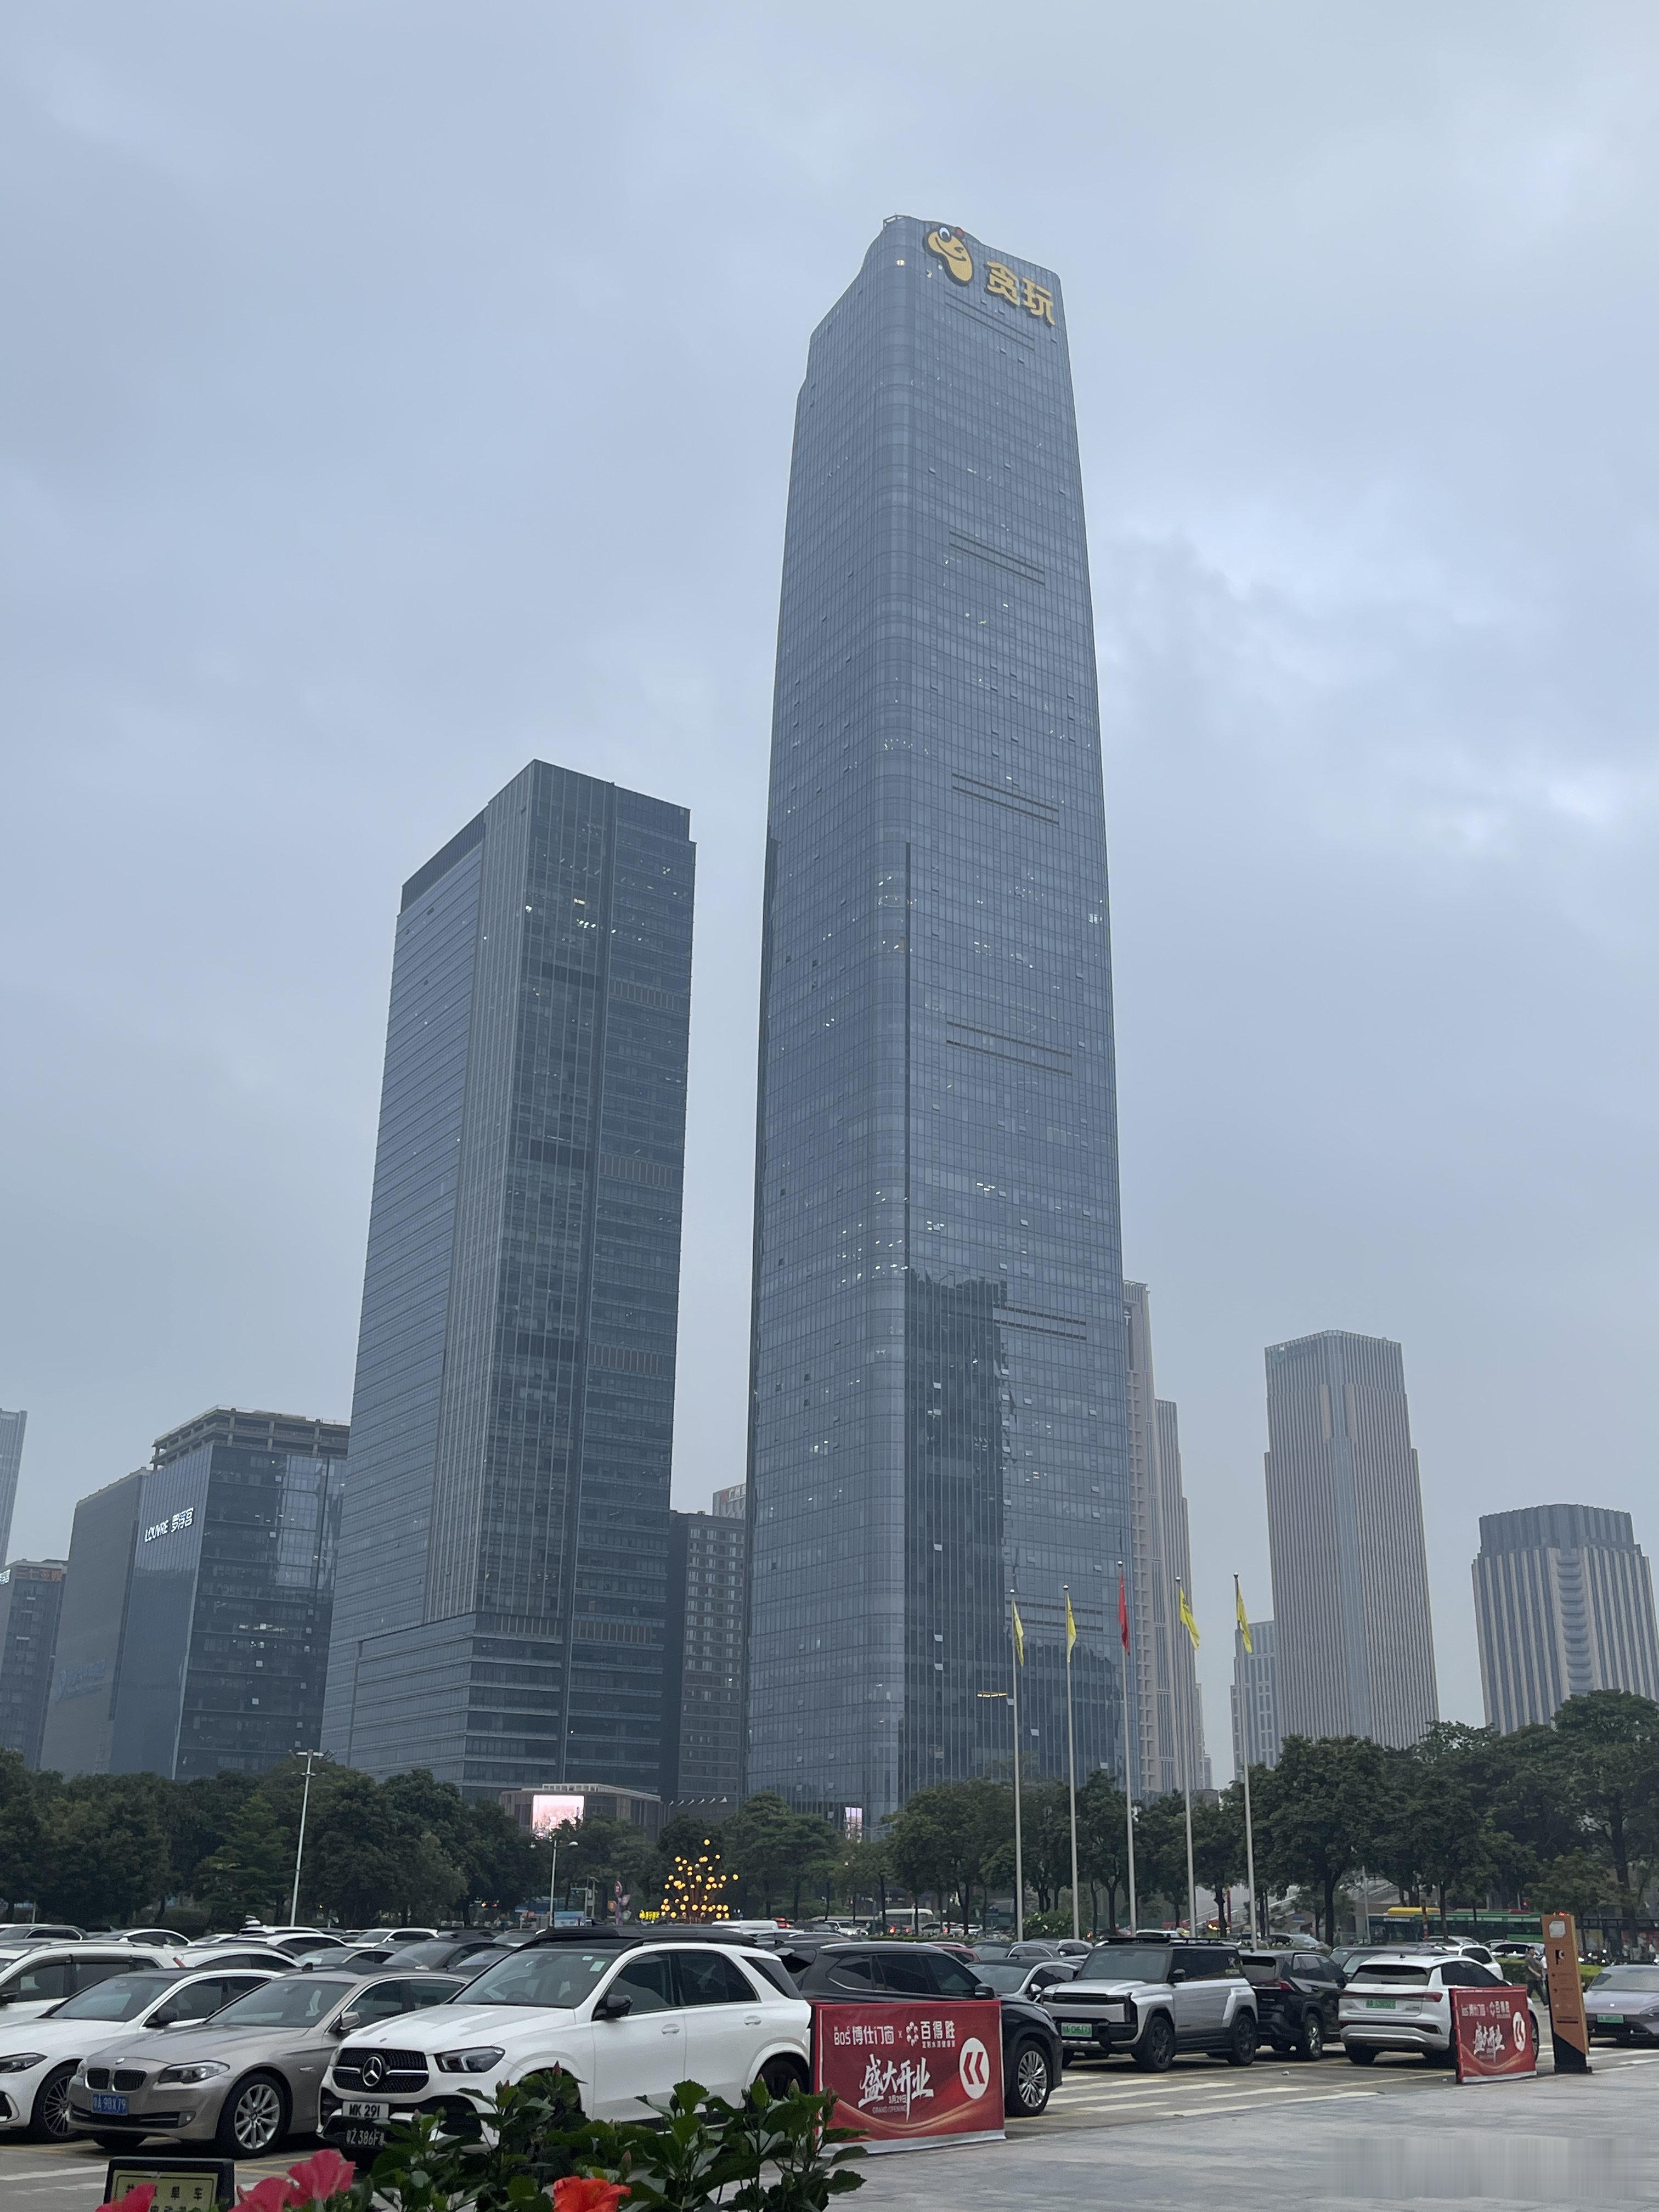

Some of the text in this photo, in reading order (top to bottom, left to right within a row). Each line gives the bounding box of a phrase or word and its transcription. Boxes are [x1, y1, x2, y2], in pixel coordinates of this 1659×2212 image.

[986, 260, 1056, 326] 贪玩
[144, 1519, 169, 1543] LOUVRE
[171, 1507, 194, 1533] 罗浮宫
[852, 2025, 894, 2046] 博仕门窗
[920, 2020, 956, 2040] 百得胜
[857, 2053, 934, 2122] 盛大开业
[349, 2103, 381, 2117] MK 291
